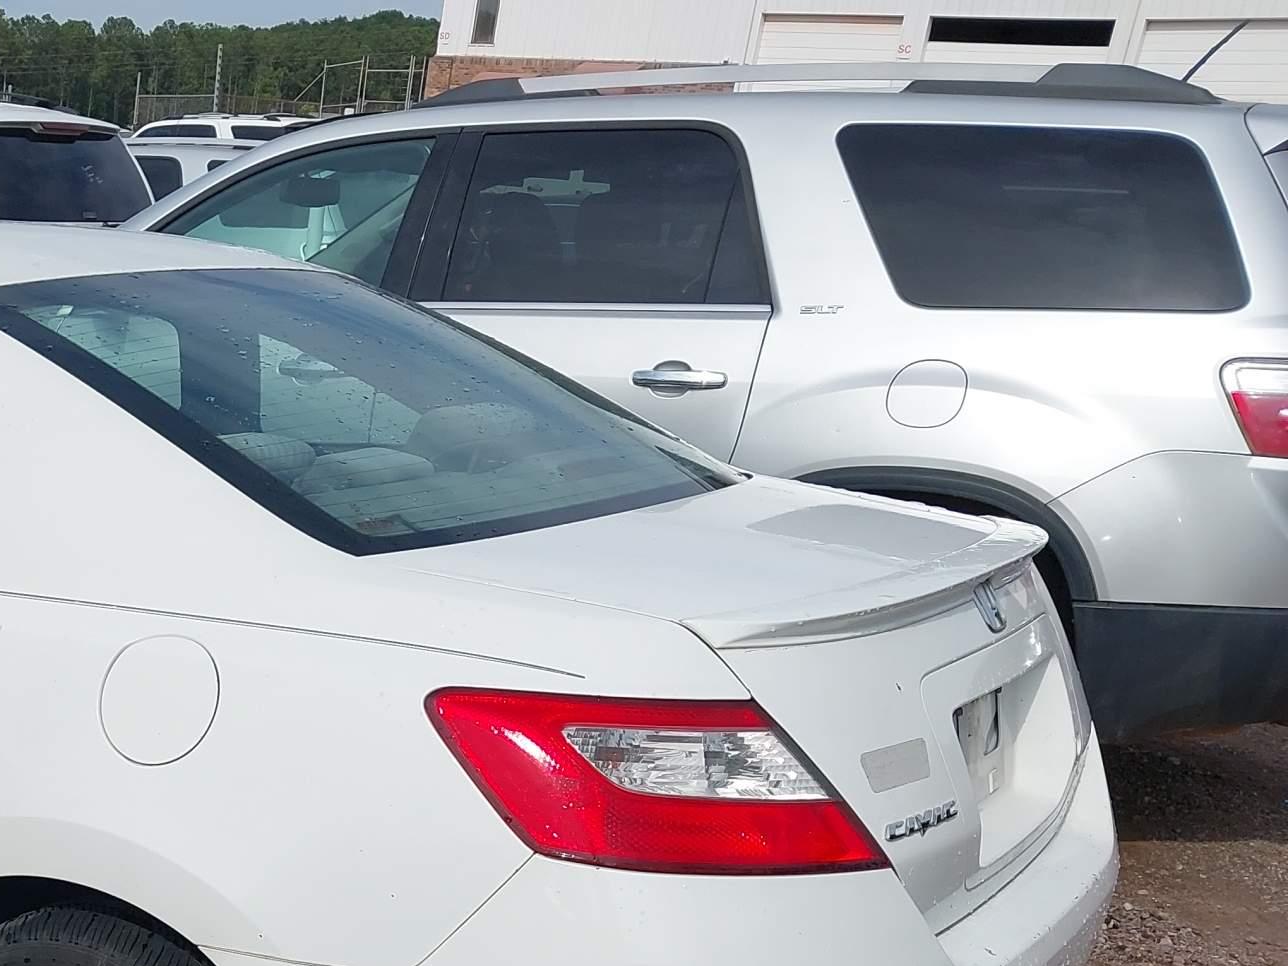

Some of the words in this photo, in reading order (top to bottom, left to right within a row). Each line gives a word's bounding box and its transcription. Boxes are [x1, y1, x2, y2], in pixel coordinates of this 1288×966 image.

[439, 31, 450, 40] SD
[897, 44, 912, 54] SC
[799, 304, 845, 315] SLT
[884, 799, 959, 842] CIVIC
